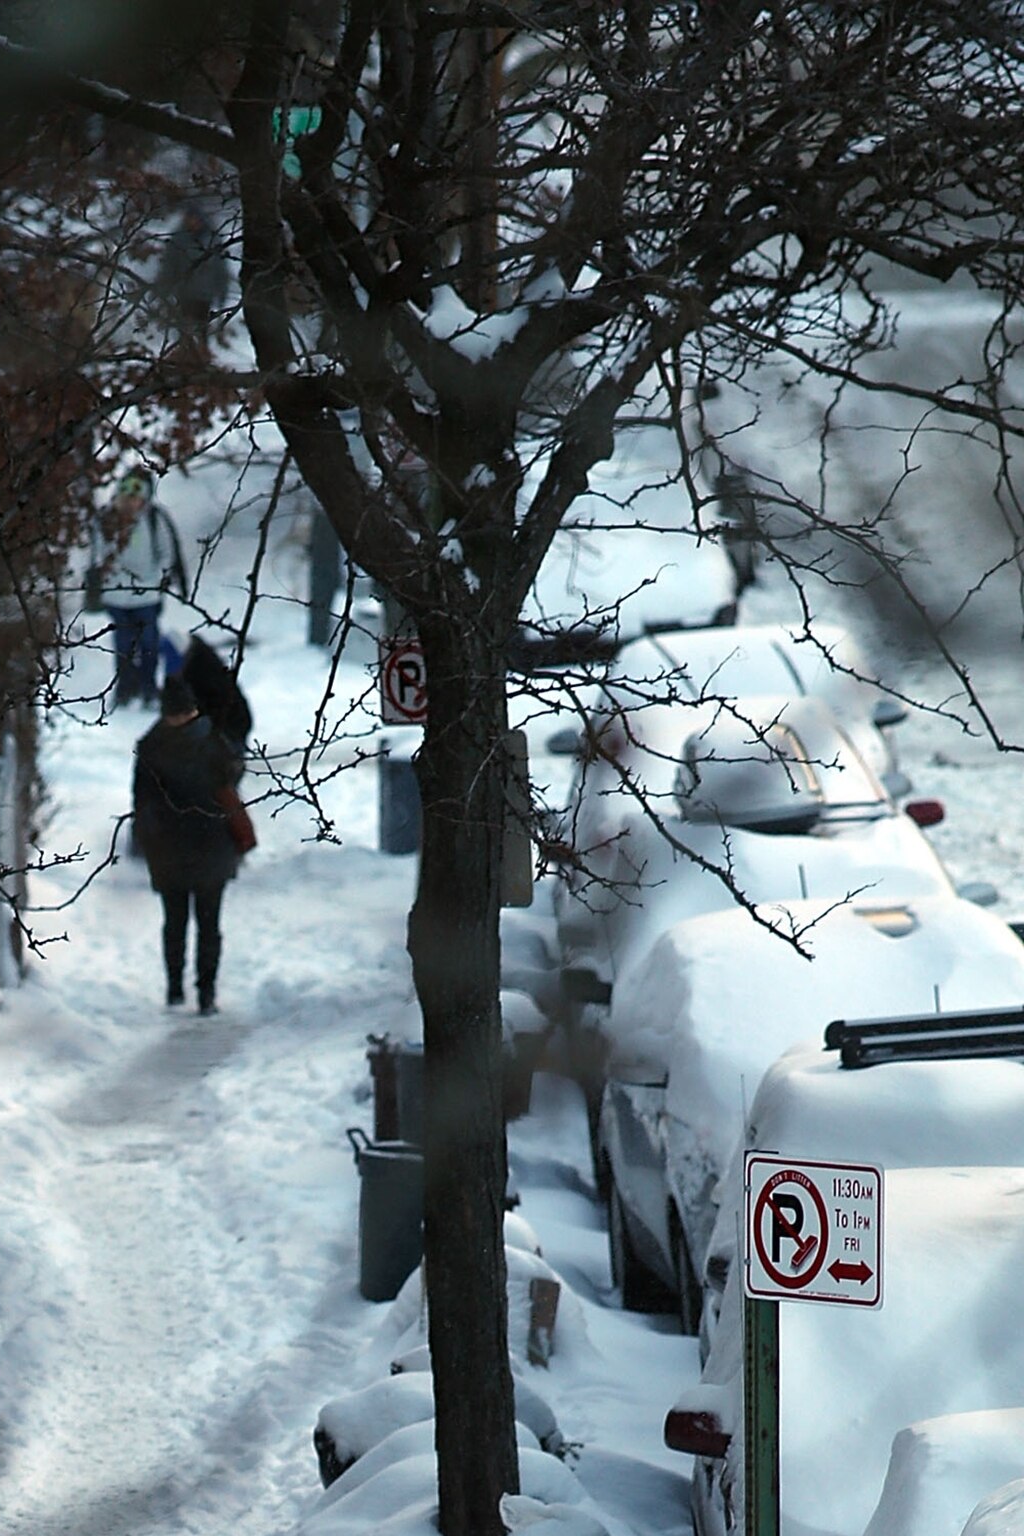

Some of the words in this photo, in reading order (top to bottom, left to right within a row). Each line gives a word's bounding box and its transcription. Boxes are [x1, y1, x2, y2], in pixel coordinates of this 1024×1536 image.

[833, 1178, 873, 1200] 11:30AM
[853, 1210, 870, 1230] 1PM
[844, 1237, 860, 1252] FRI
